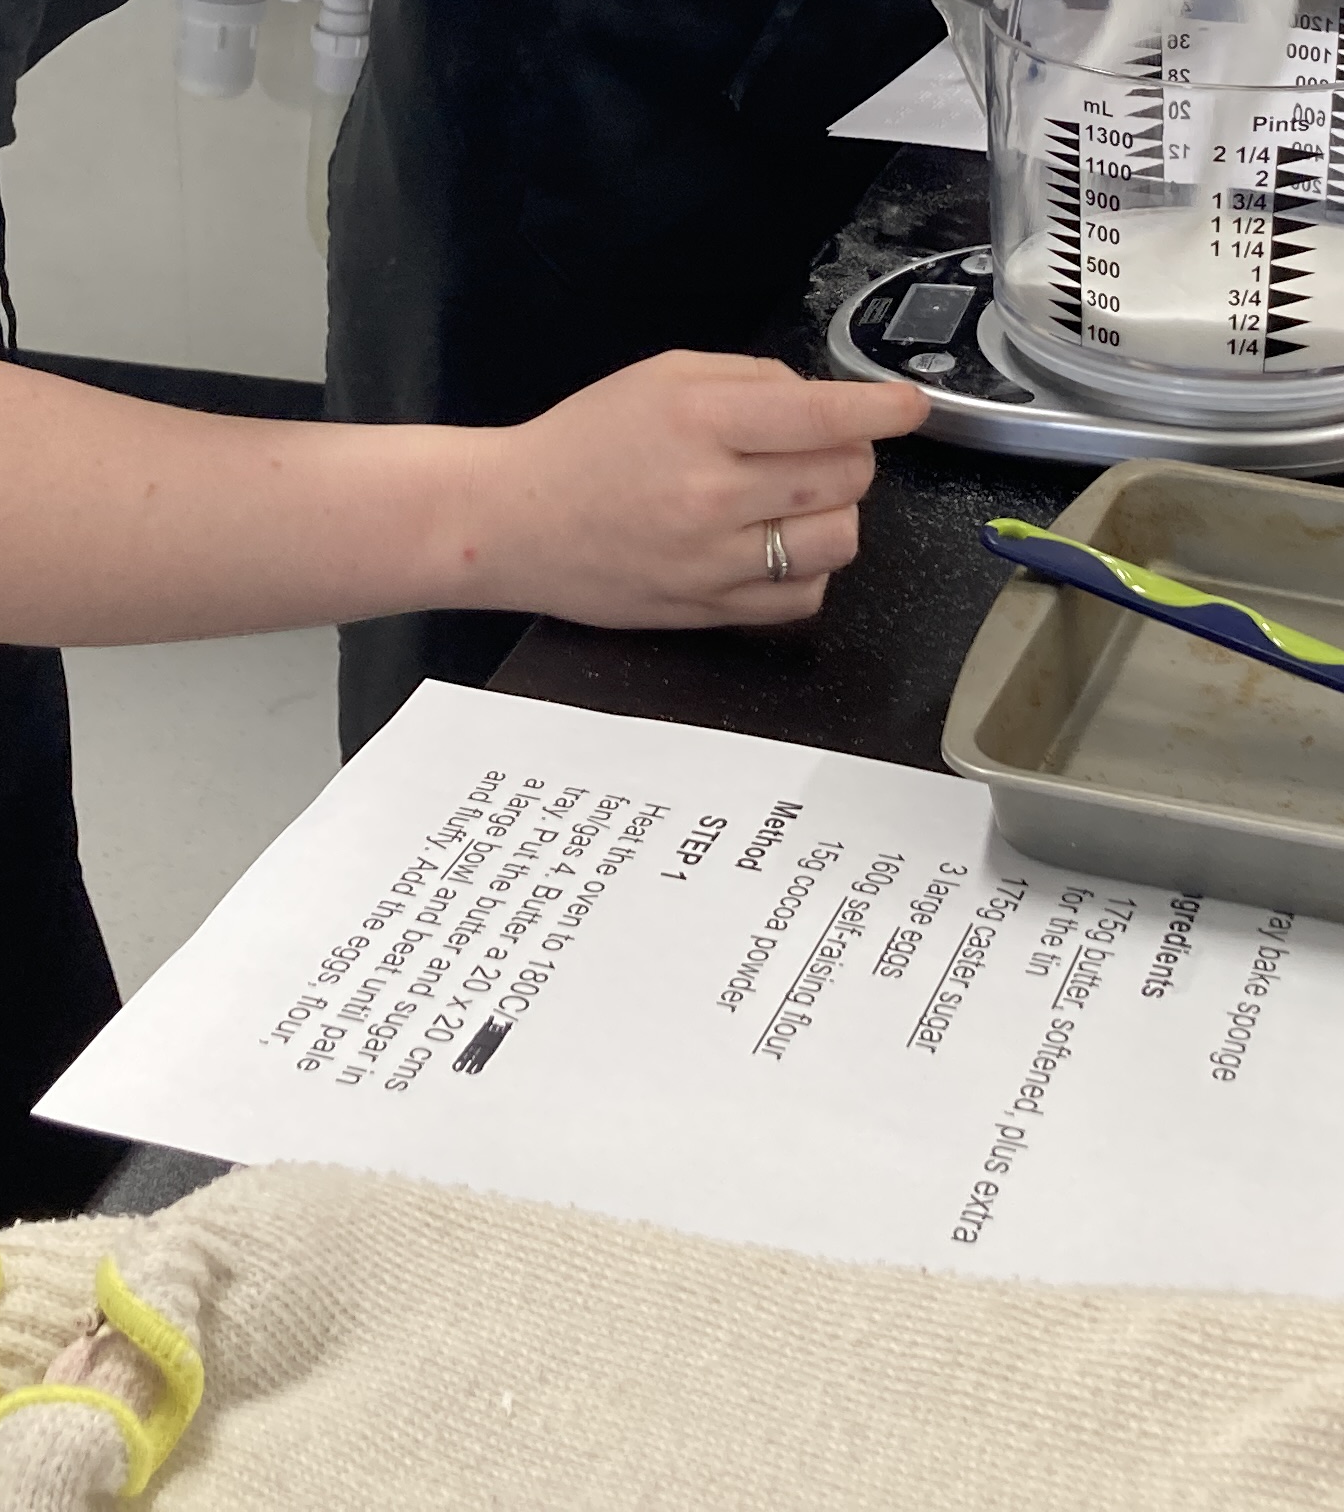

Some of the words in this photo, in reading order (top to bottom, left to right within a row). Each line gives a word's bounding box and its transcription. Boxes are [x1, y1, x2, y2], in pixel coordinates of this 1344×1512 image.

[1084, 100, 1113, 118] mL
[1252, 116, 1310, 133] Pints
[1085, 124, 1134, 149] 1300
[1085, 157, 1132, 181] 1100
[1213, 146, 1226, 162] 2
[1236, 146, 1270, 164] 1/4
[1255, 170, 1268, 187] 2
[1085, 189, 1120, 212] 900
[1212, 192, 1222, 209] 1
[1233, 193, 1267, 211] 3/4
[1085, 221, 1120, 245] 700
[1211, 216, 1220, 233] 1
[1232, 217, 1265, 235] 1/2
[1086, 255, 1120, 279] 500
[1210, 240, 1219, 257] 1
[1231, 241, 1264, 258] 1/4
[1251, 265, 1261, 282] 1
[1086, 289, 1120, 313] 300
[1228, 289, 1261, 307] 3/4
[1087, 324, 1120, 347] 100
[1228, 314, 1260, 331] 1/2
[1227, 338, 1259, 356] 1/4
[466, 769, 507, 804] and
[521, 777, 545, 790] a
[484, 792, 541, 837] large
[540, 785, 591, 821] tray.
[423, 805, 484, 851] fluffy.
[561, 793, 631, 858] fan/gas
[616, 801, 672, 844] Heat
[674, 814, 728, 866] STEP
[733, 799, 804, 873] Method
[511, 826, 560, 860] Put
[594, 845, 637, 876] the
[795, 840, 845, 872] 15g
[389, 855, 440, 897] Add
[446, 840, 503, 885] bowl
[487, 862, 531, 892] the
[543, 861, 577, 878] 4.
[659, 870, 688, 881] 1
[850, 852, 906, 896] 160g
[938, 861, 968, 876] 3
[361, 899, 406, 931] the
[413, 886, 457, 926] and
[498, 883, 564, 945] Butter
[556, 879, 606, 928] oven
[763, 874, 815, 932] cocoa
[908, 877, 961, 925] large
[974, 877, 1029, 922] 175g
[1057, 886, 1095, 914] for
[441, 895, 507, 956] butter
[1039, 916, 1079, 947] the
[1083, 898, 1137, 944] 175g
[1257, 909, 1295, 942] ray
[373, 927, 434, 975] beat
[482, 945, 508, 961] a
[540, 931, 575, 952] to
[785, 898, 871, 1007] self-raising
[871, 928, 923, 979] eggs
[947, 924, 997, 989] caster
[1140, 892, 1203, 999] gredients
[306, 934, 370, 987] eggs,
[406, 956, 451, 999] and
[461, 963, 502, 993] 20
[715, 933, 778, 1014] powder
[1024, 951, 1062, 977] tin
[1052, 946, 1115, 1010] butter,
[1243, 944, 1290, 997] bake
[336, 977, 387, 1023] until
[444, 994, 473, 1011] x
[258, 994, 329, 1045] flour,
[357, 999, 418, 1063] sugar
[423, 1012, 465, 1043] 20
[760, 1010, 813, 1061] flour
[905, 990, 963, 1055] sugar
[295, 1022, 348, 1071] pale
[1208, 1000, 1261, 1082] sponge
[334, 1063, 375, 1085] in
[383, 1046, 433, 1092] cms
[1003, 1017, 1075, 1117] softened,
[982, 1122, 1028, 1174] plus
[950, 1179, 1000, 1244] extra
